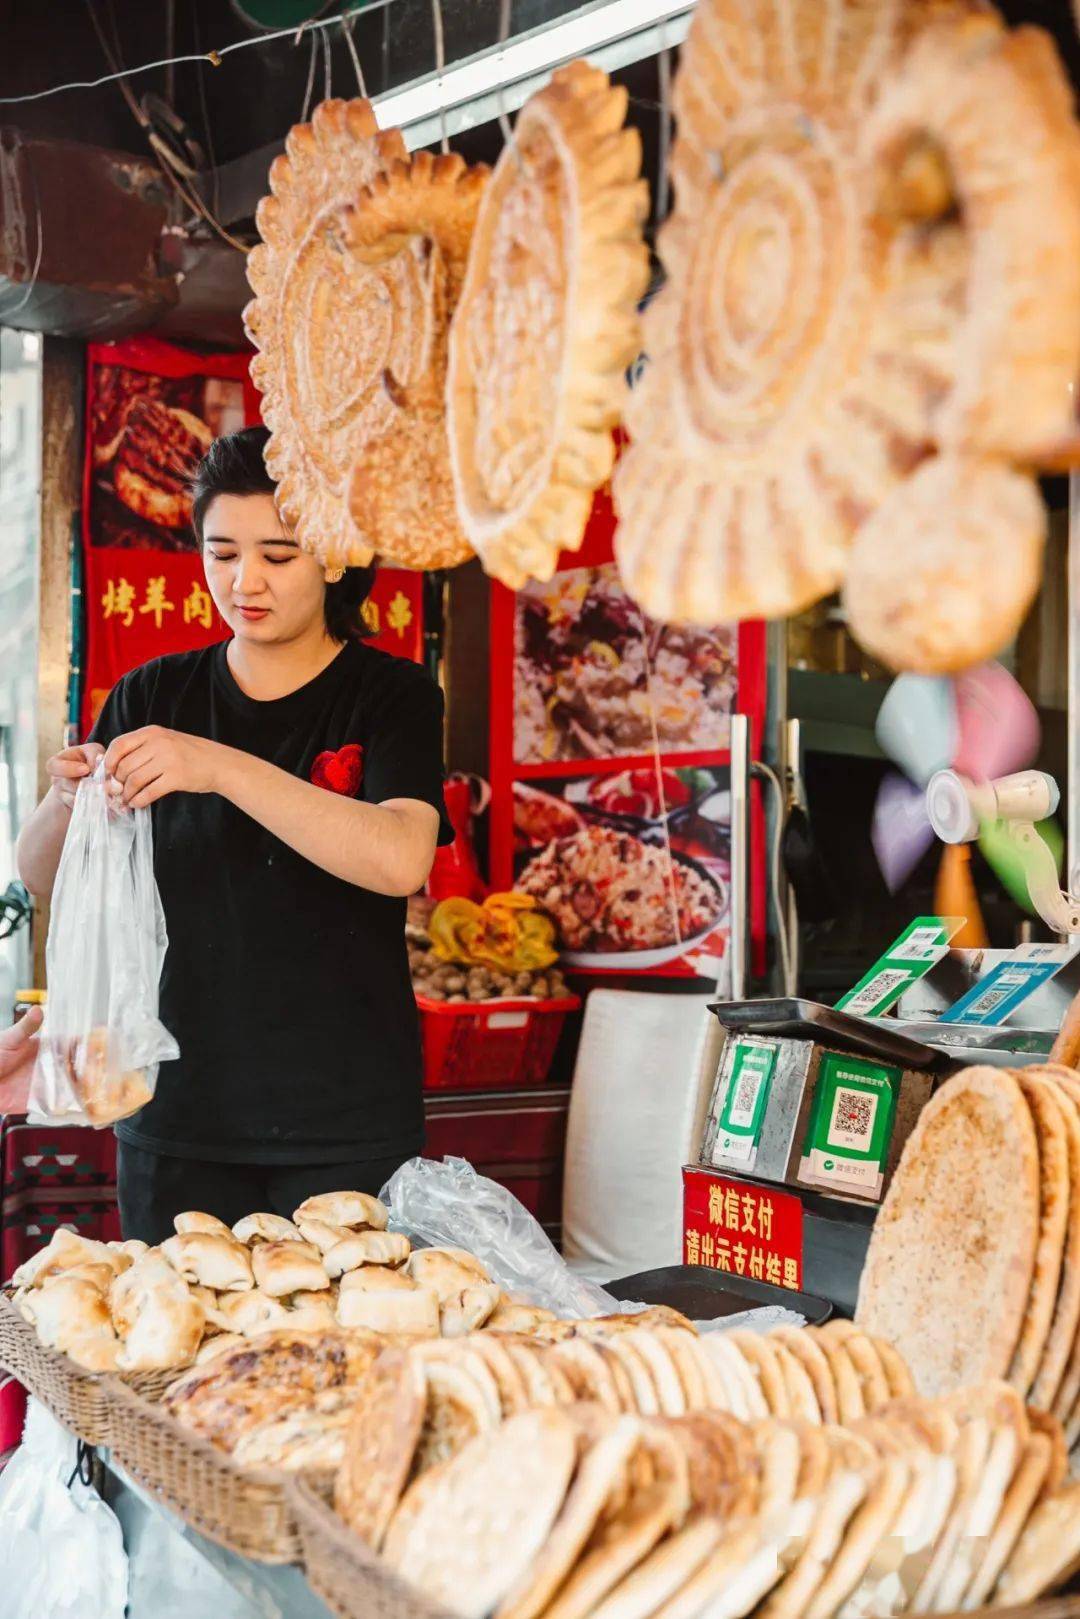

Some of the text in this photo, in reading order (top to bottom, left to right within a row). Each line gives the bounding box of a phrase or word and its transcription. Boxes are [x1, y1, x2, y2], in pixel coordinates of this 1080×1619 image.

[101, 575, 213, 629] 烤羊肉
[708, 1183, 774, 1241] 微信支付
